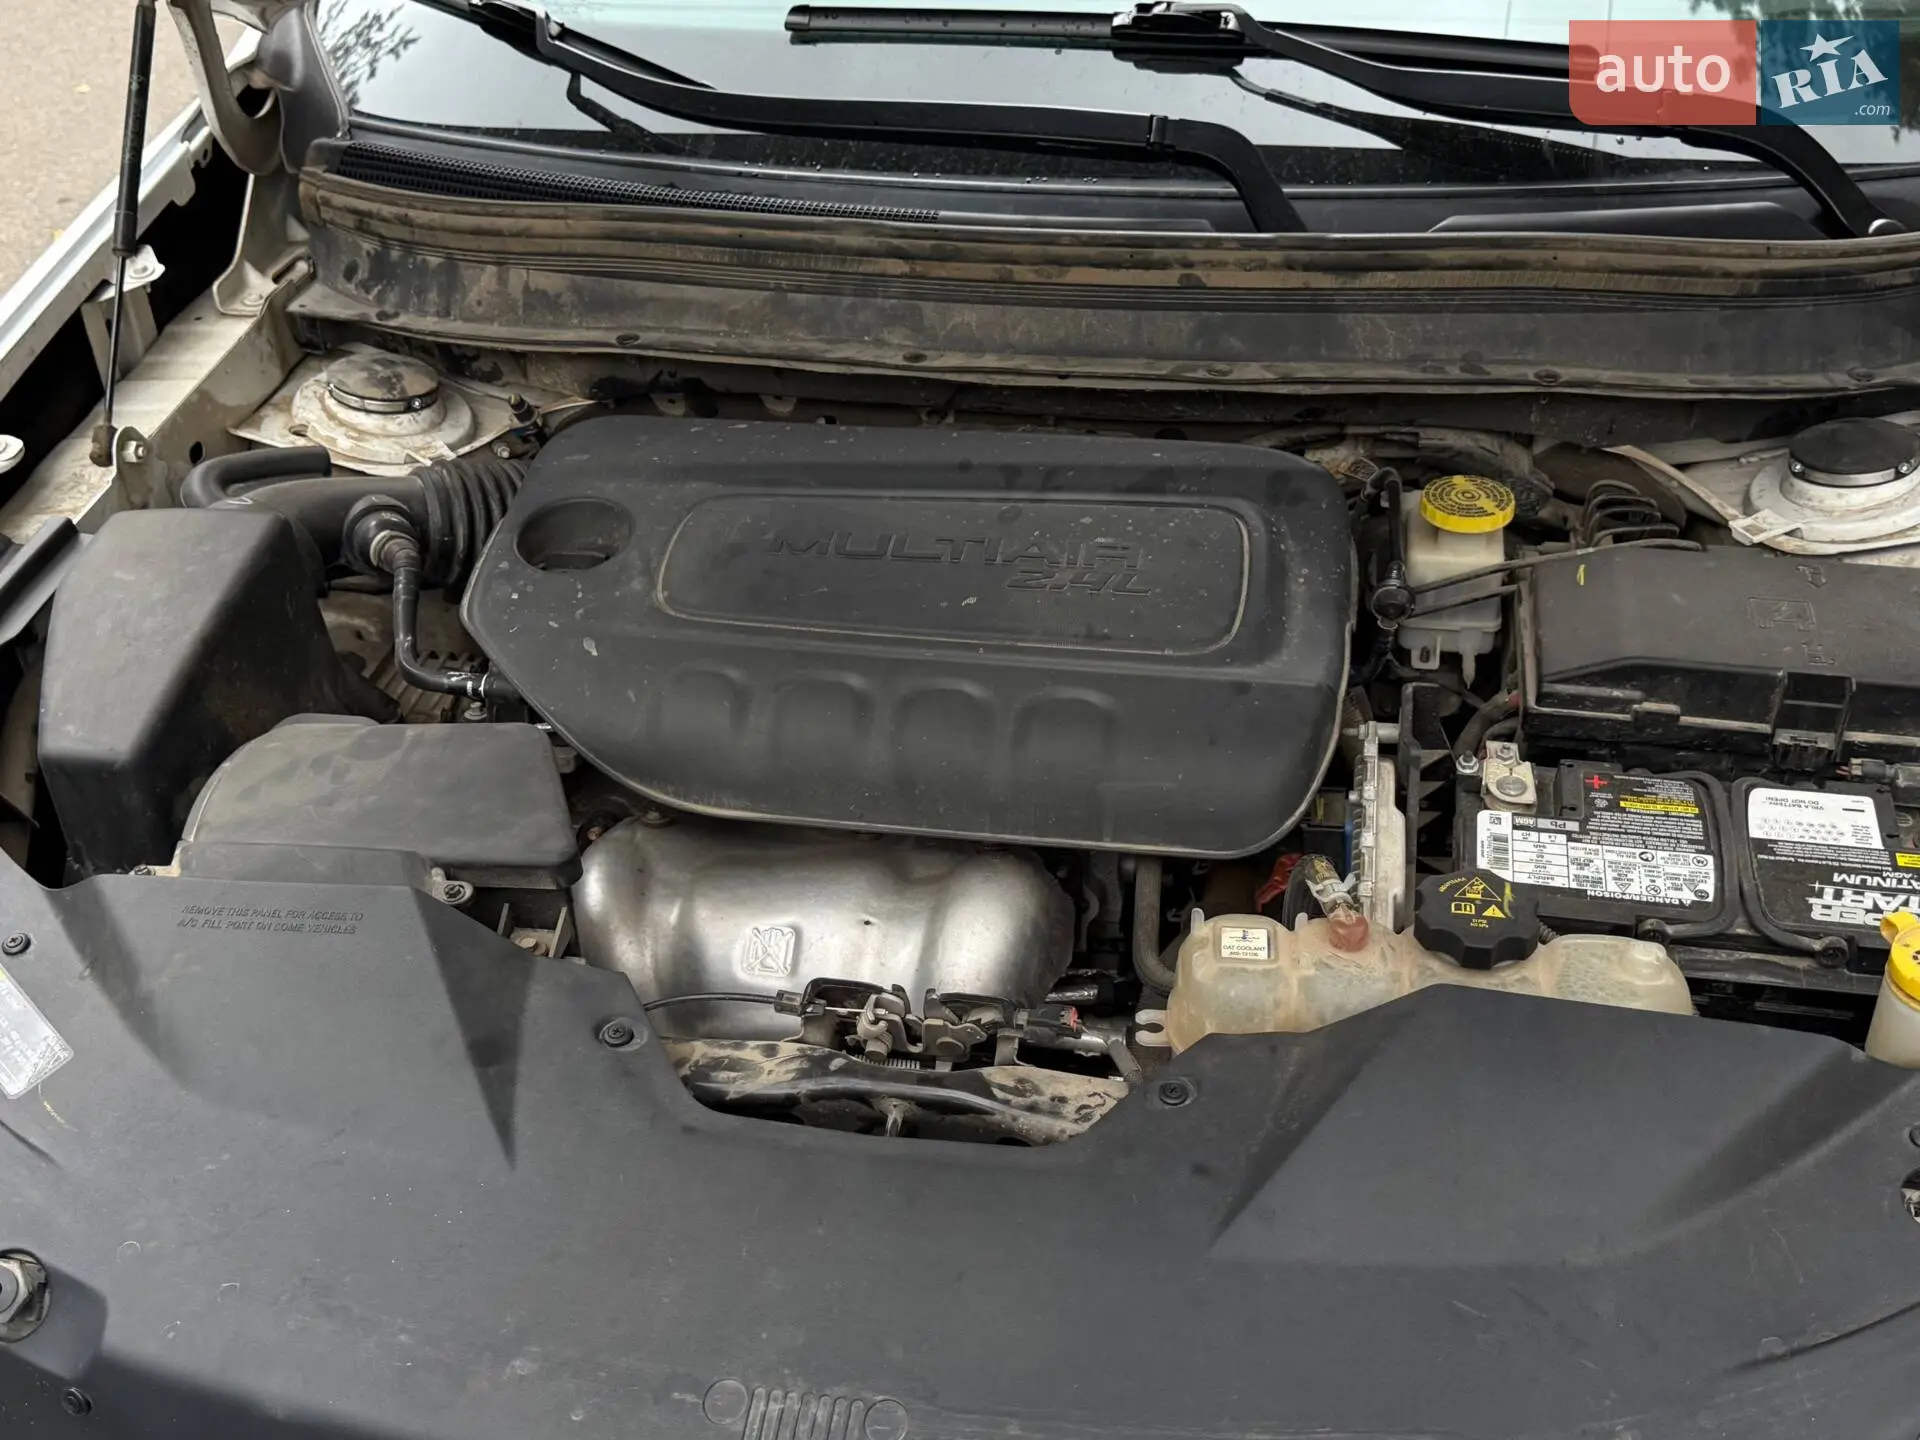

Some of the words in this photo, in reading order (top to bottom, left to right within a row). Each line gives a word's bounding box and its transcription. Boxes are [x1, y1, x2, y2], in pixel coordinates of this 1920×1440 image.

[766, 531, 1145, 570] MULTIAIR
[1005, 568, 1152, 595] 2.4L
[1514, 816, 1534, 826] AGM
[1550, 821, 1567, 829] Pb
[1832, 872, 1920, 891] ATINUM
[1586, 890, 1680, 904] DANGER/POISON
[1822, 888, 1920, 914] TART
[182, 905, 225, 917] REMOVE
[227, 907, 249, 917] THIS
[251, 908, 282, 919] PANEL
[285, 909, 306, 920] FOR
[307, 910, 347, 921] ACCESS
[351, 911, 364, 922] TO
[1810, 904, 1887, 927] PER
[201, 919, 223, 930] FILL
[226, 920, 253, 931] PORT
[256, 921, 272, 932] ON
[274, 922, 305, 933] SOME
[307, 923, 357, 935] VEHICLES
